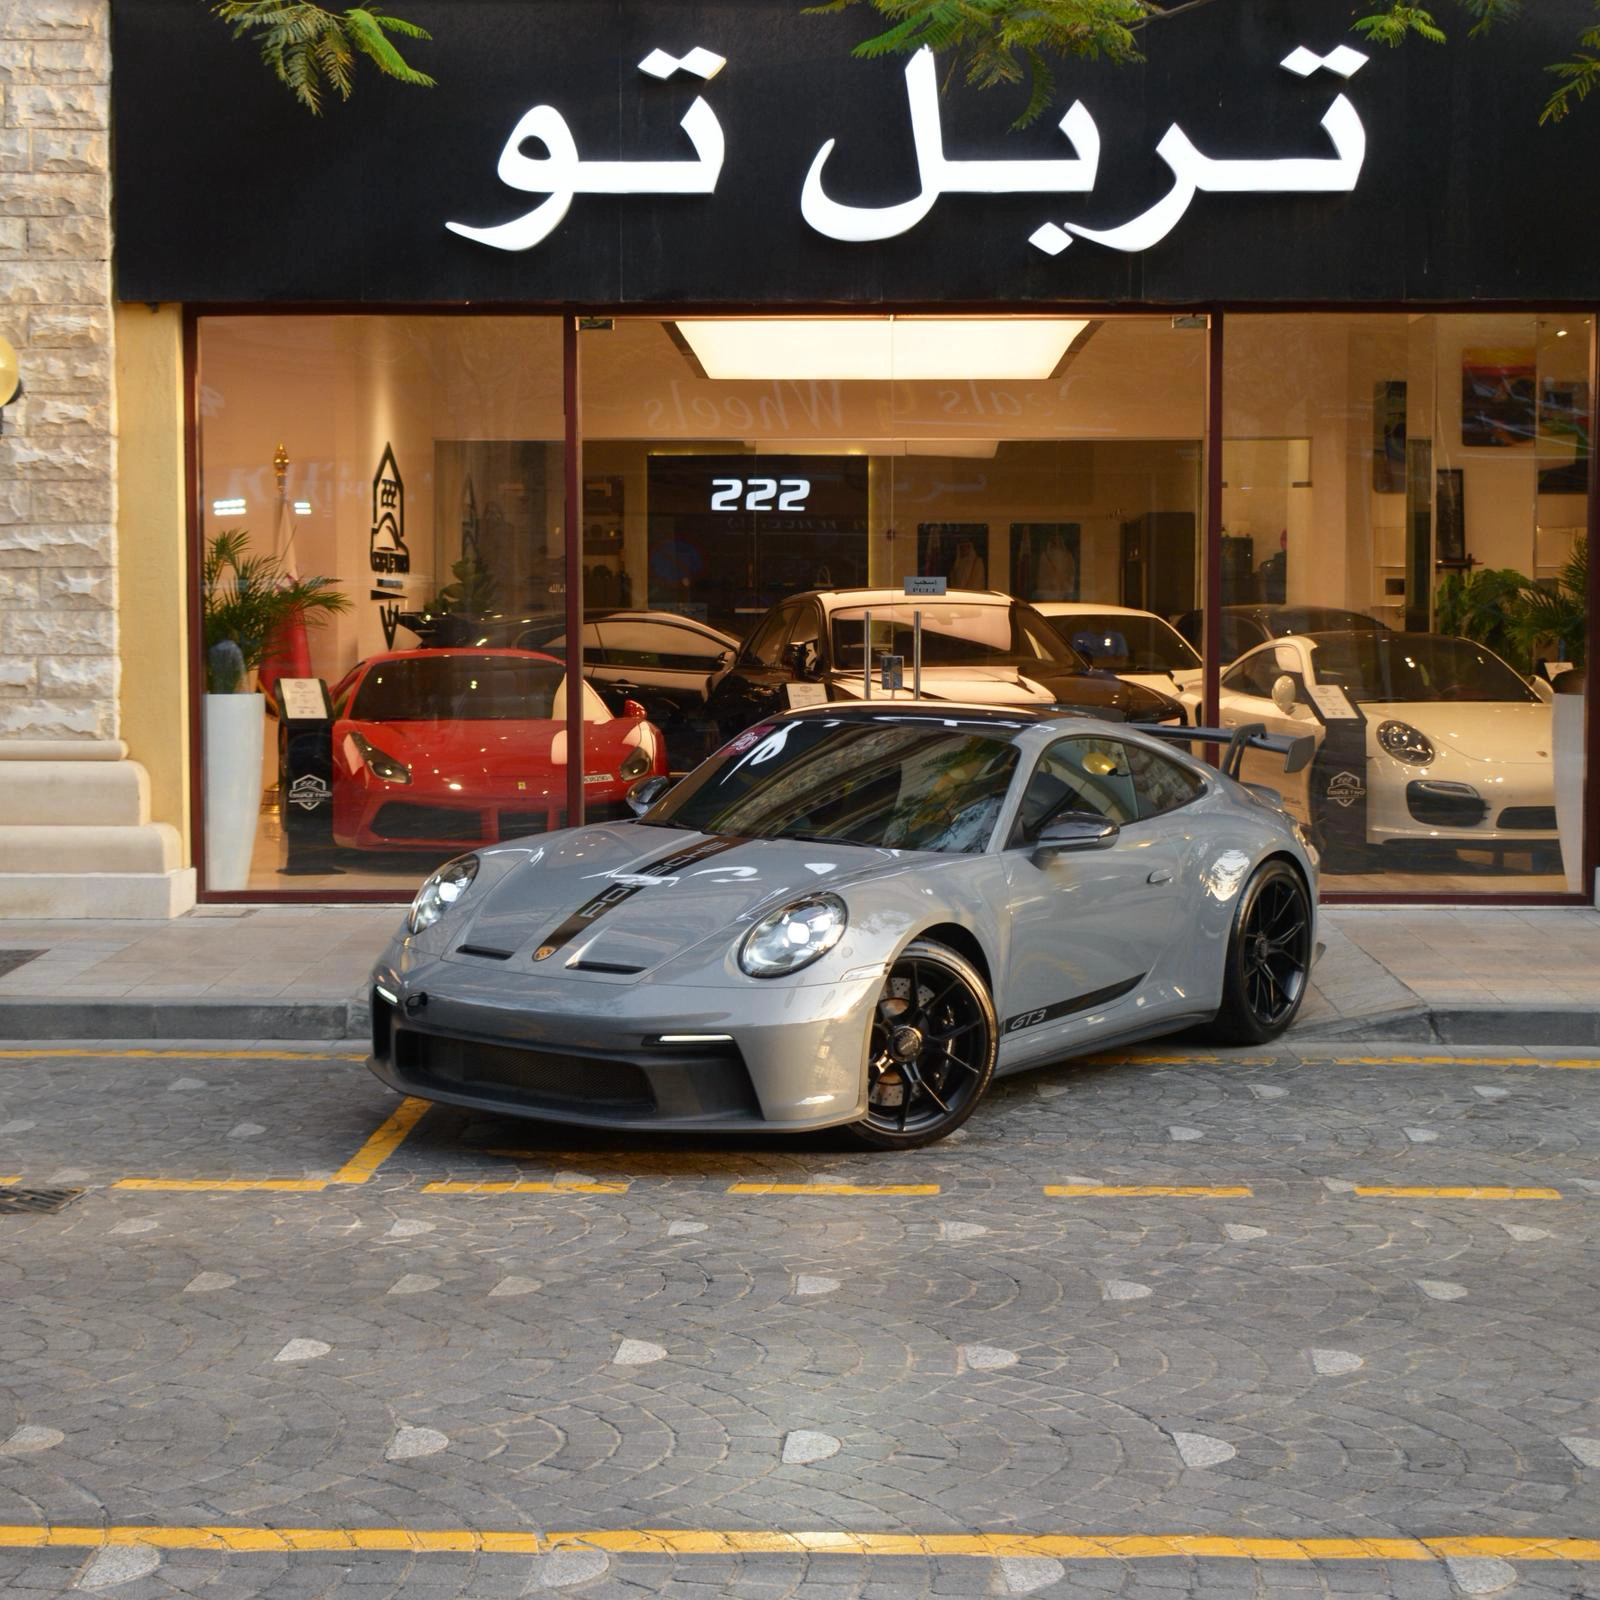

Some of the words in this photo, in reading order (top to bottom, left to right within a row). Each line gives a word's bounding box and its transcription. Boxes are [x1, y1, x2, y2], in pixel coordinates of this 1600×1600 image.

[445, 46, 727, 251] تو
[801, 45, 1369, 256] تربل
[710, 478, 811, 512] 222
[580, 840, 731, 919] POSCHE
[1010, 1008, 1048, 1030] GT3
